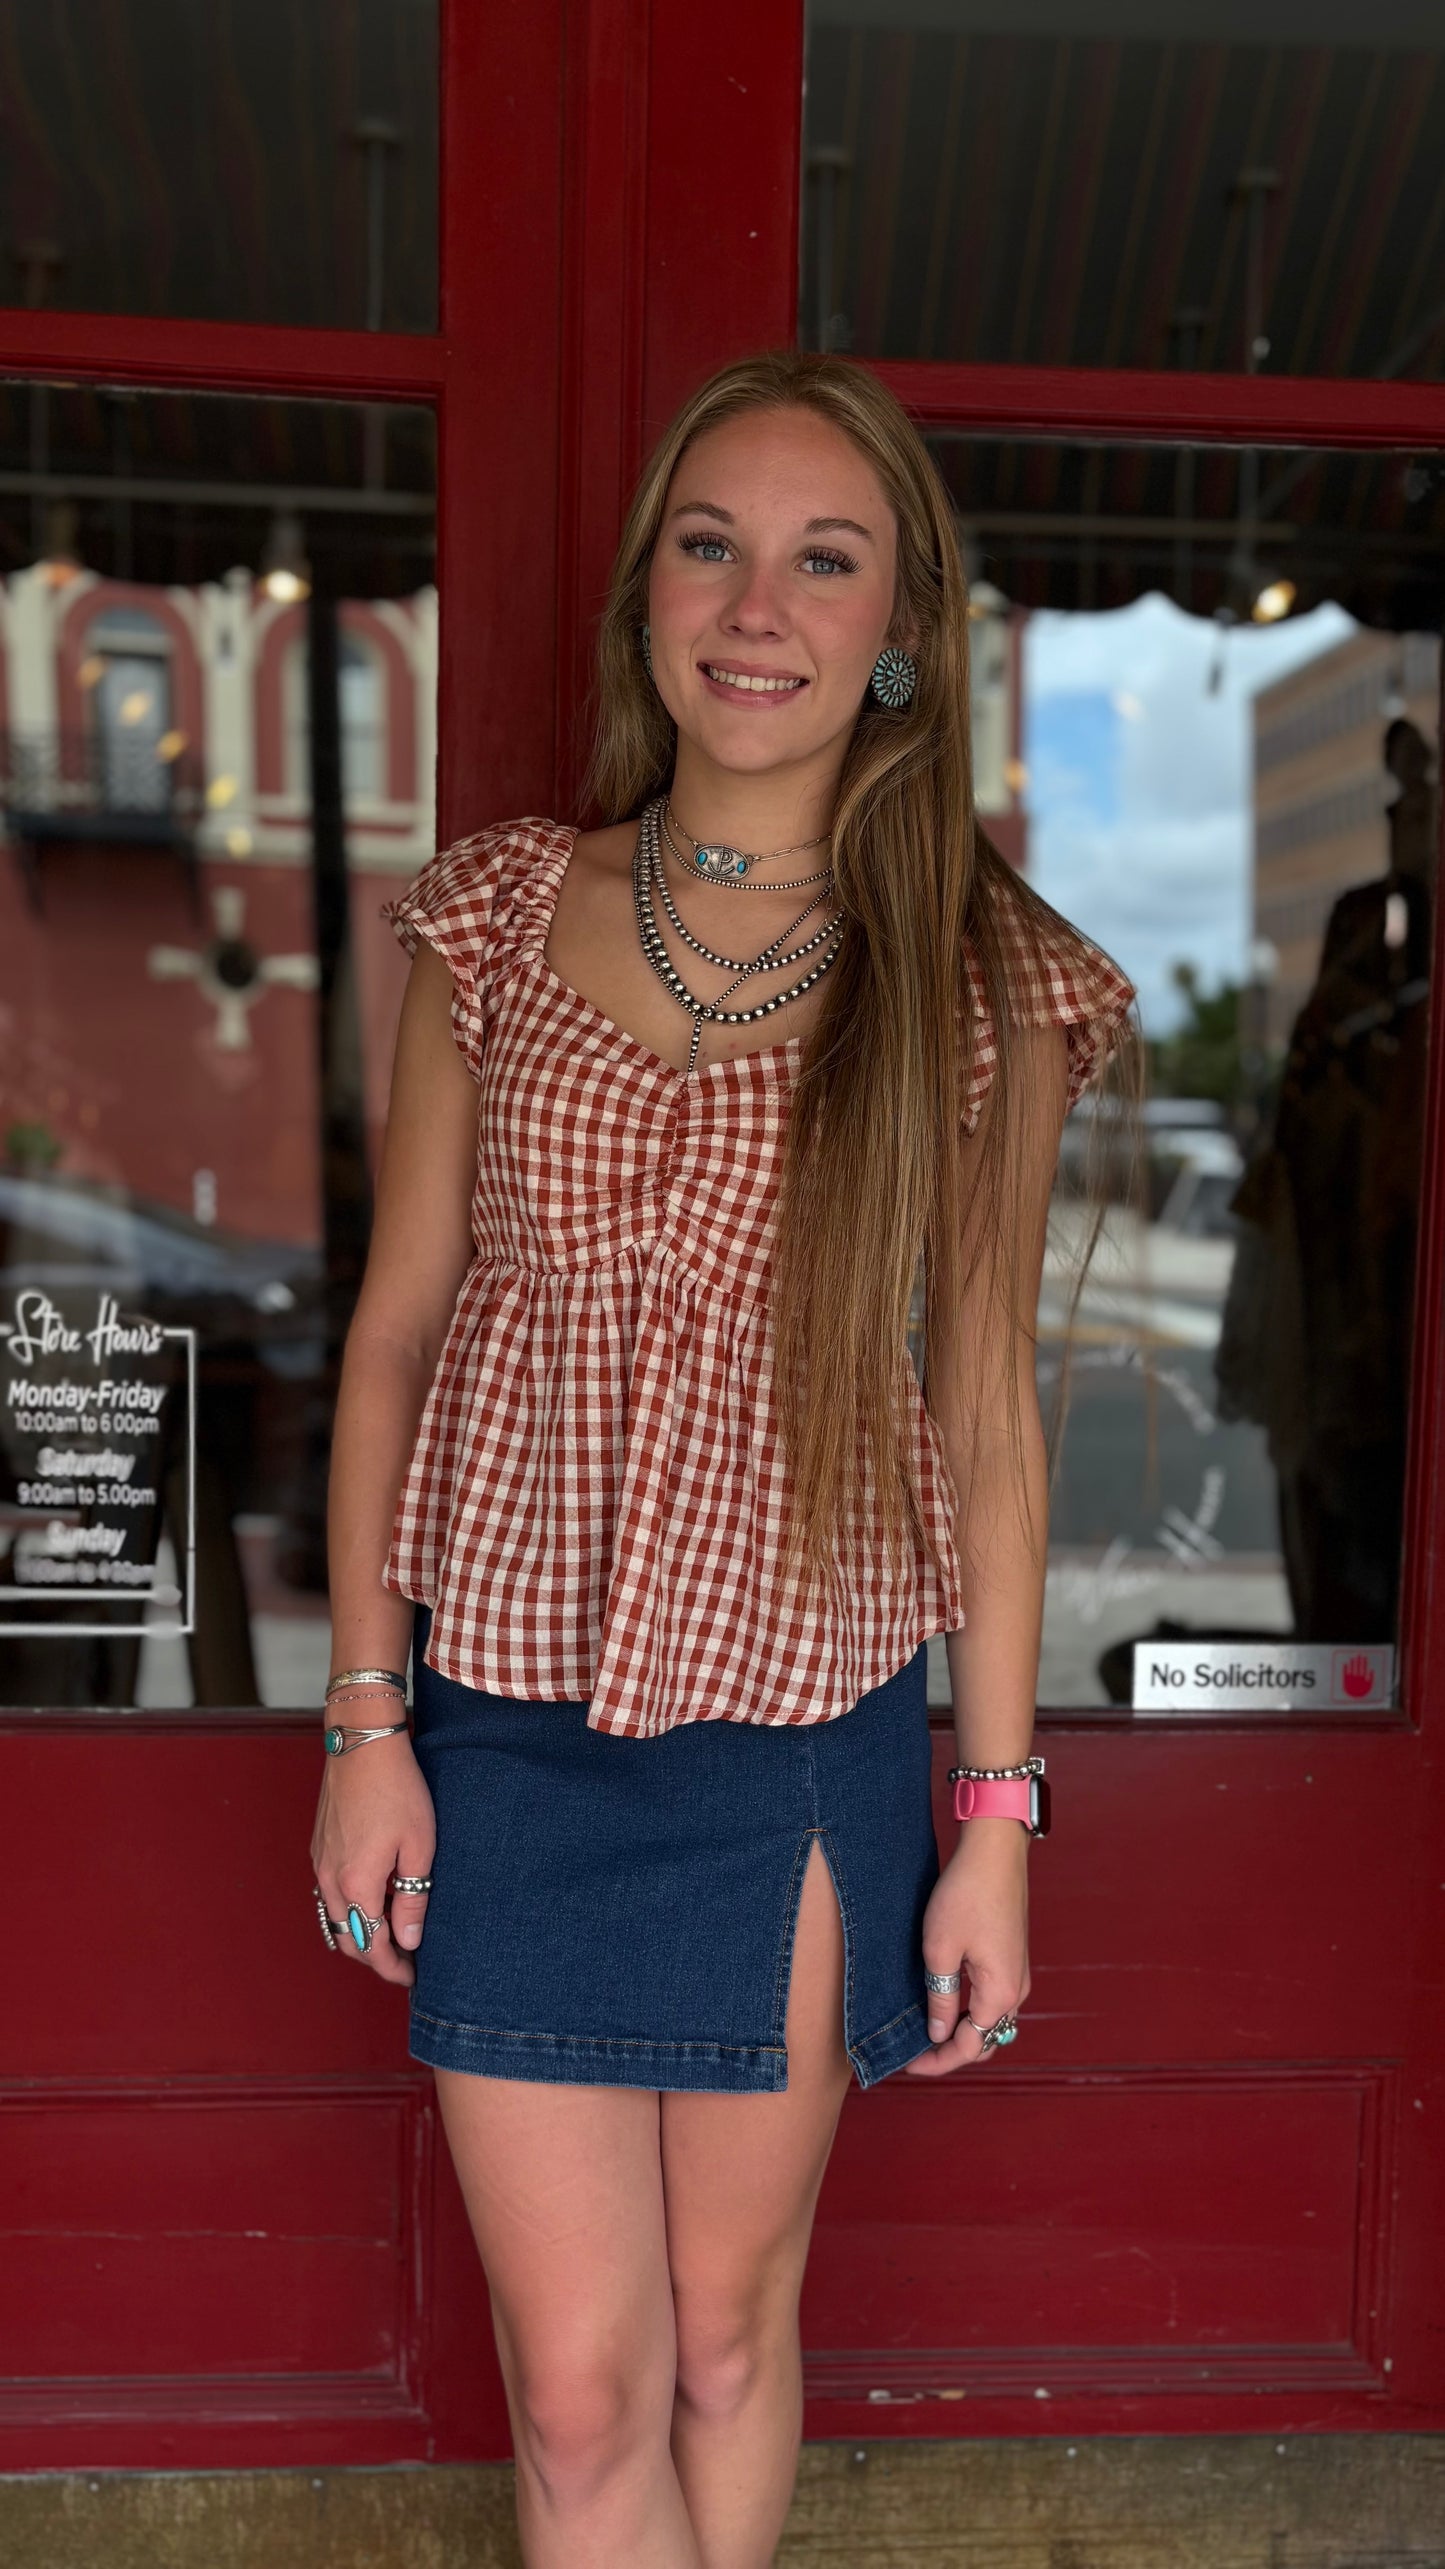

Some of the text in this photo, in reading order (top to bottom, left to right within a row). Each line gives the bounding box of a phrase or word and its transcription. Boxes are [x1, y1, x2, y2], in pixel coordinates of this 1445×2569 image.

[8, 1290, 163, 1366] Store Hours
[8, 1378, 167, 1413] Monday-Friday
[80, 1413, 98, 1434] to
[100, 1412, 160, 1437] 600pm
[78, 1484, 96, 1505] to
[1150, 1662, 1317, 1689] No Solicitors
